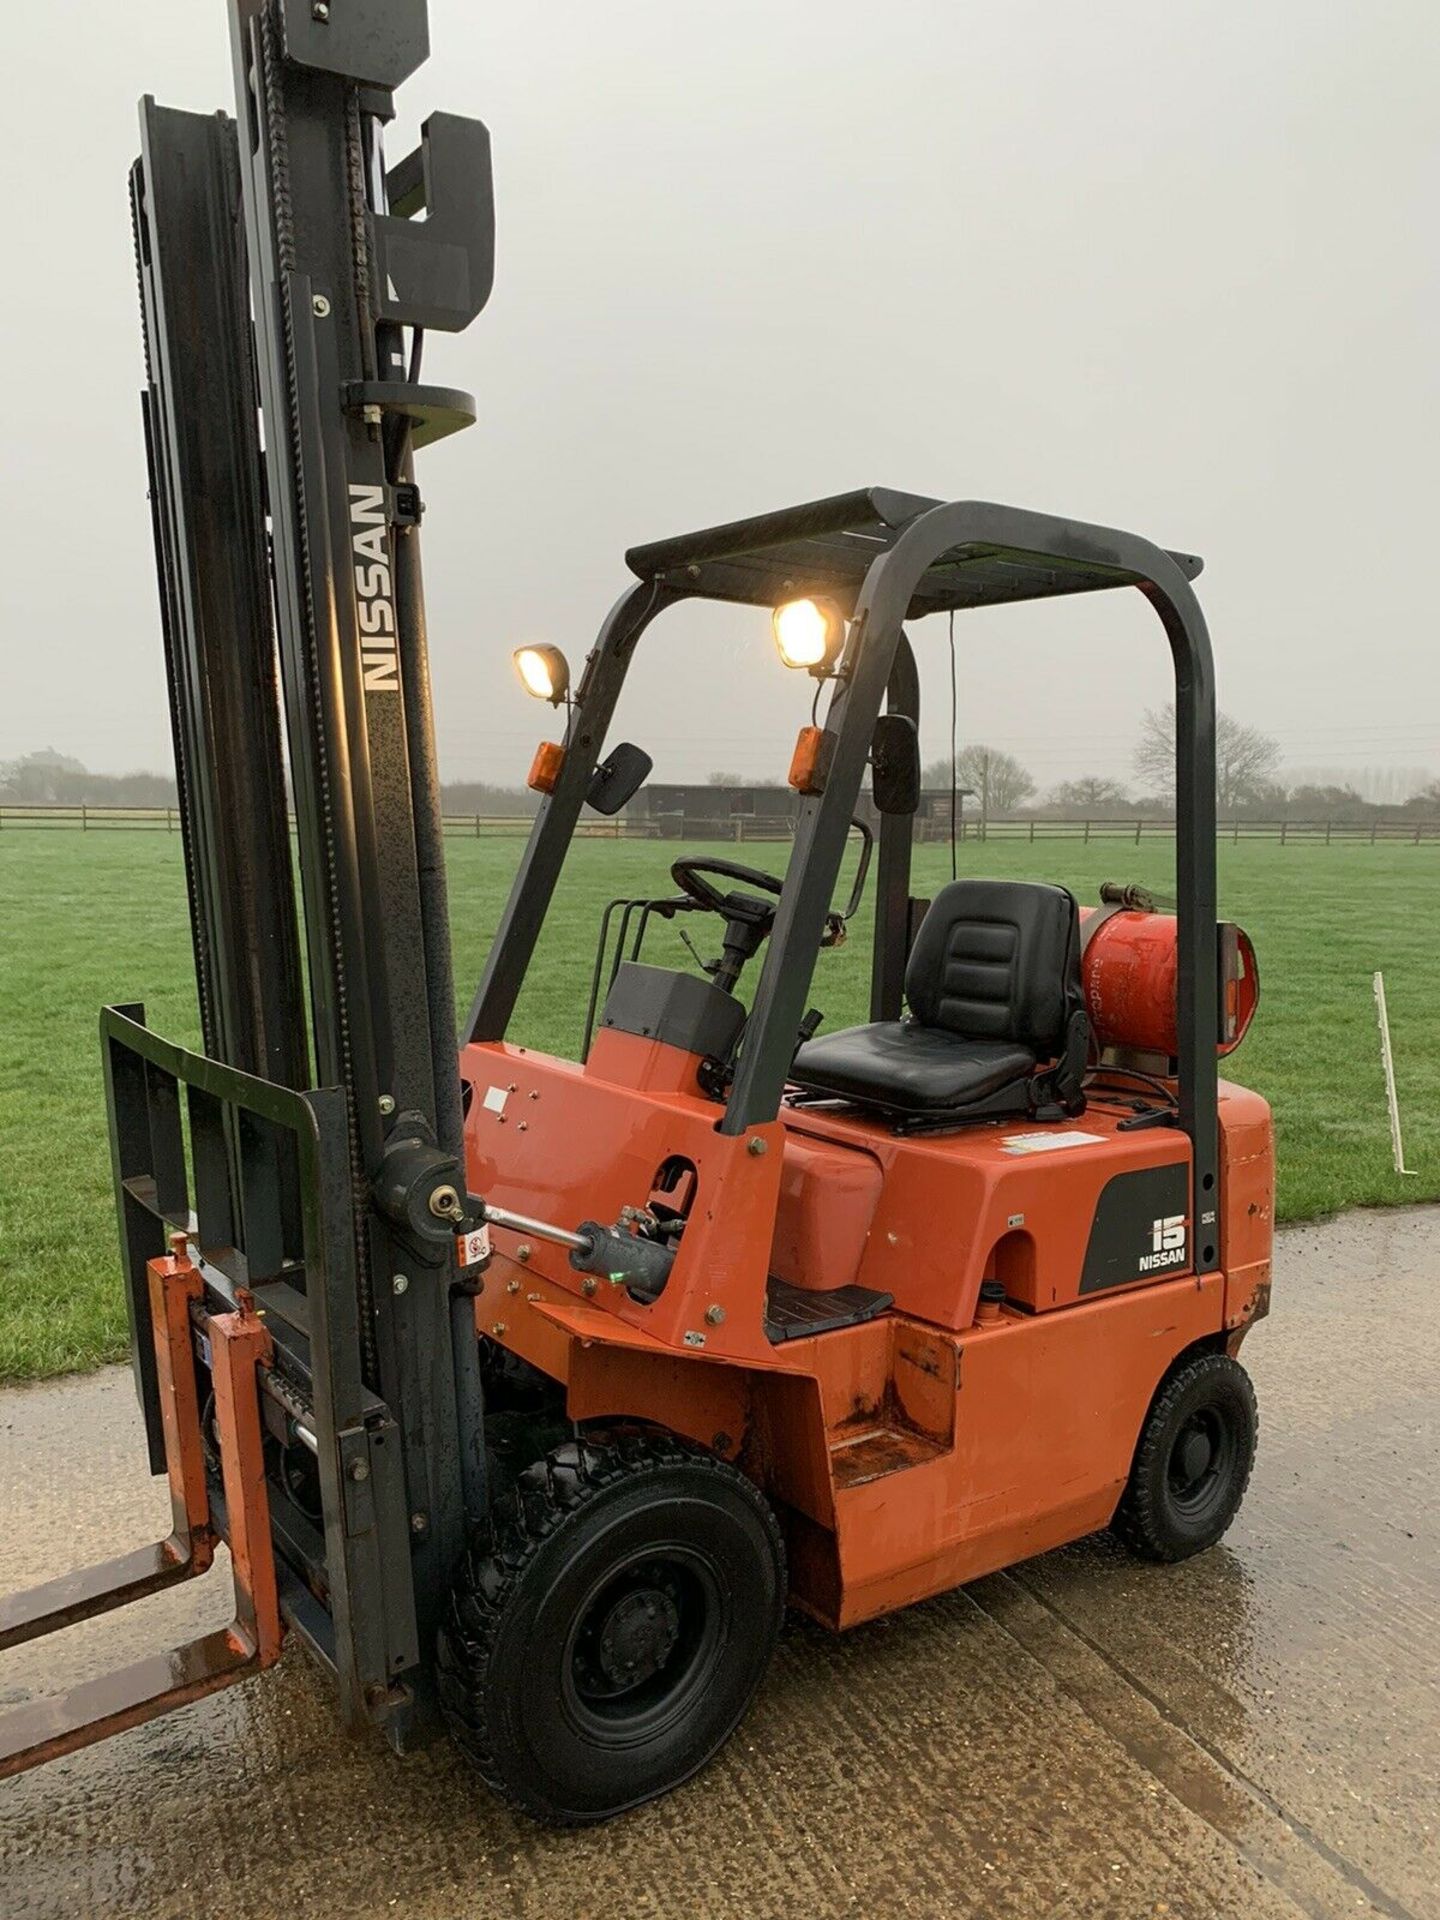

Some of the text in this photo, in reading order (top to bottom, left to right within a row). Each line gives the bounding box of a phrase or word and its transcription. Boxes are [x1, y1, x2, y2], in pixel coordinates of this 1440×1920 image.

[348, 484, 399, 691] NISSAN
[1153, 1214, 1185, 1252] 15
[1139, 1248, 1185, 1272] NISSAN
